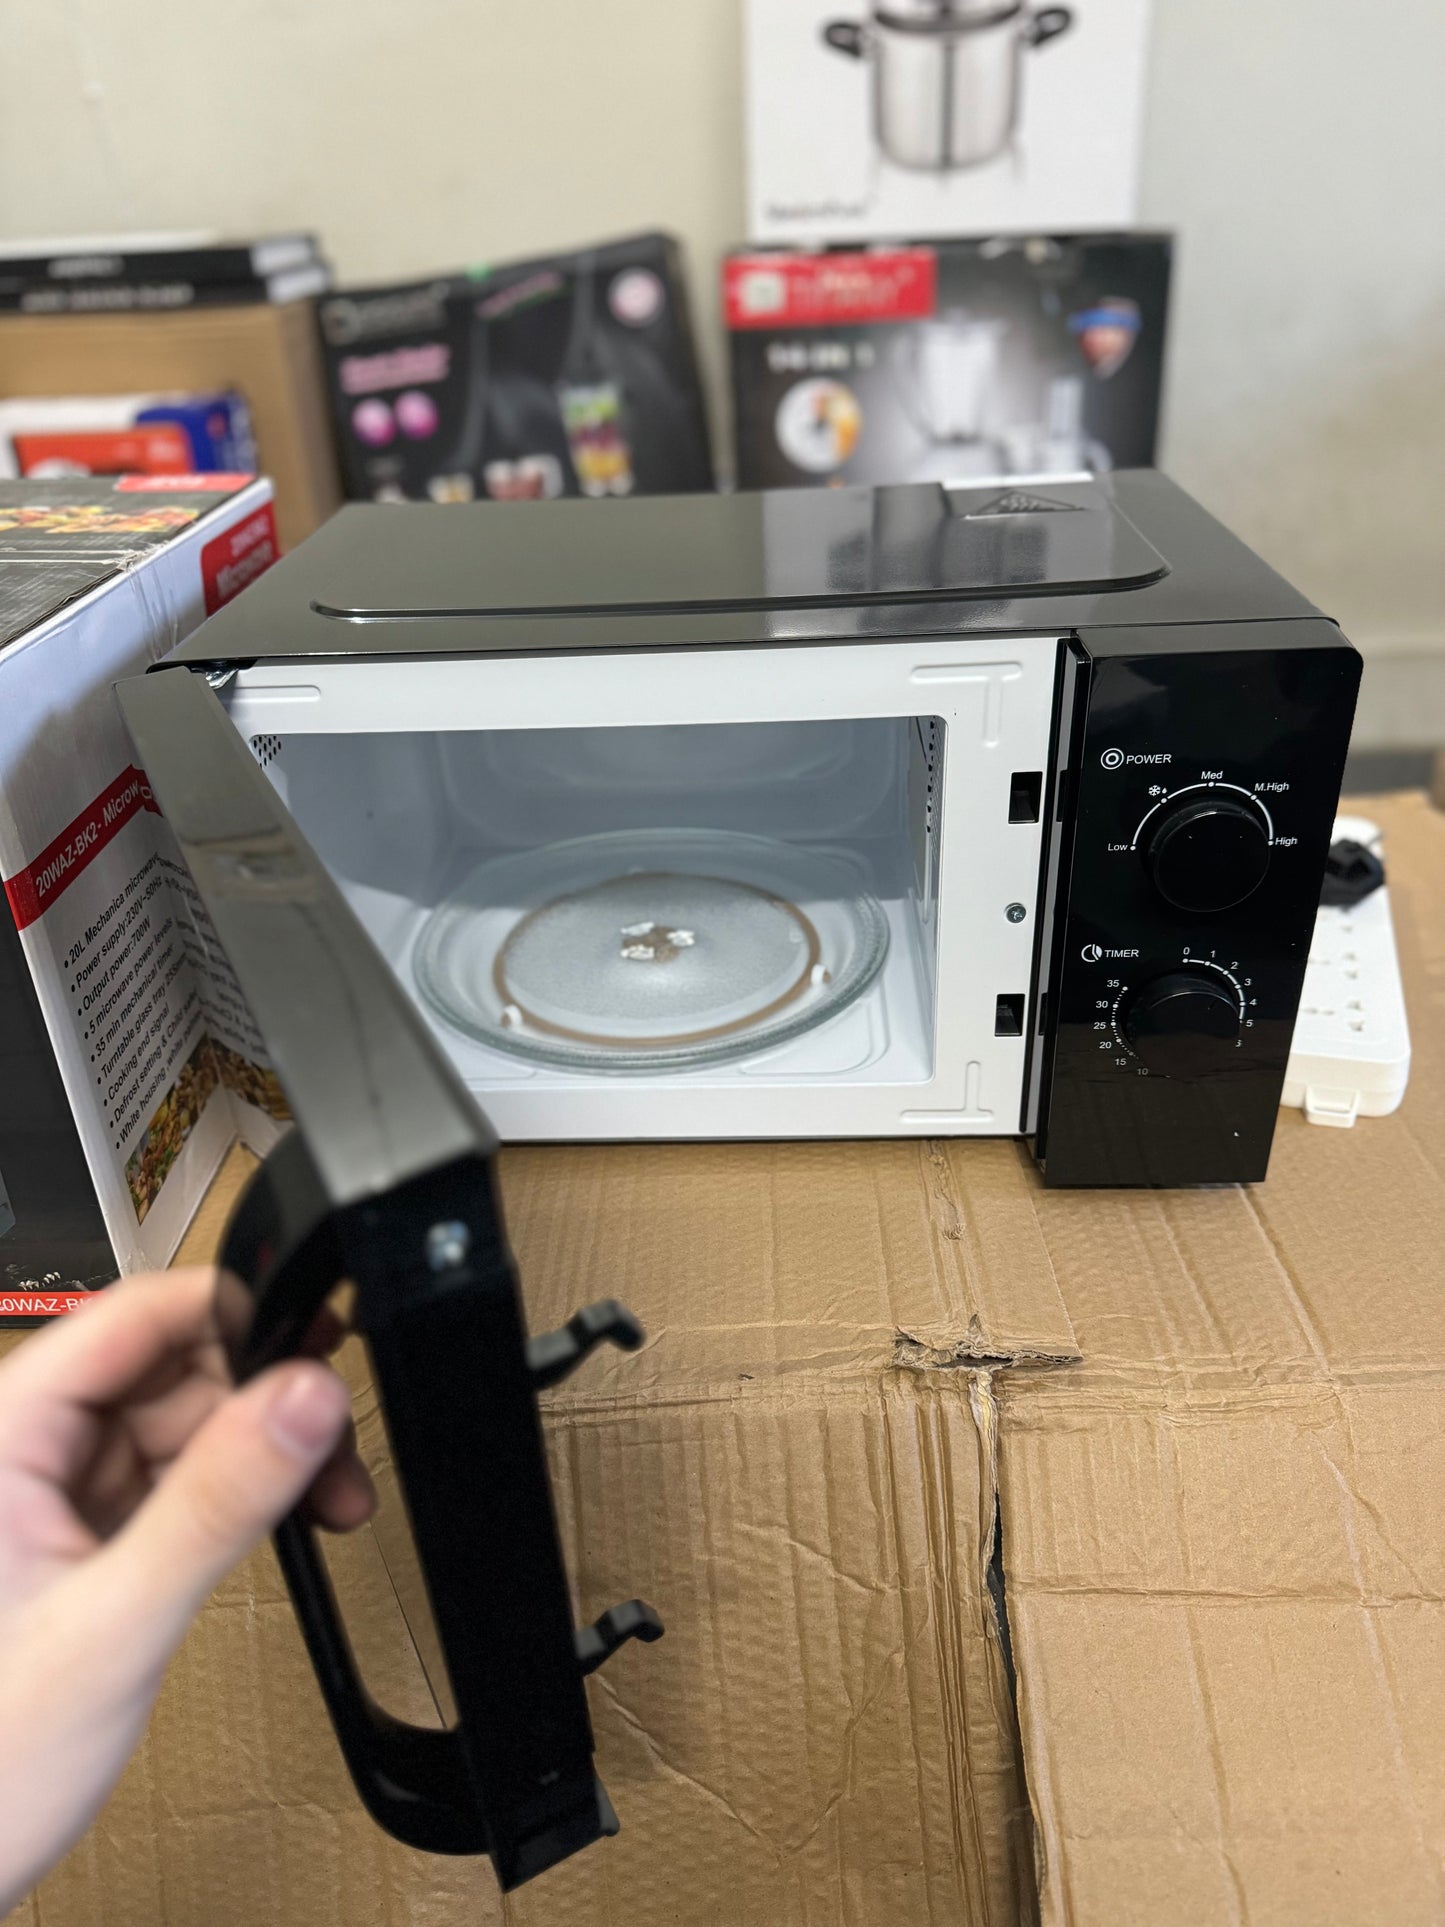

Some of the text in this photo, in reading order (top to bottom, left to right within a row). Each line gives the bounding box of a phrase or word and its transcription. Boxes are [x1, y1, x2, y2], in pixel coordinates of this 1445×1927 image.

[1126, 754, 1172, 765] POWER
[1201, 770, 1223, 780] Med
[1254, 782, 1290, 792] M.High
[1275, 836, 1298, 847] High
[1108, 843, 1128, 851] Low
[69, 940, 86, 965] 20L
[84, 893, 125, 946] Mechanica
[1104, 949, 1139, 958] TIMER
[1182, 947, 1191, 955] 0
[1210, 950, 1216, 958] 1
[83, 915, 151, 1011] Output power:700W
[1231, 961, 1239, 970] 2
[76, 951, 101, 989] Power
[89, 916, 173, 1034] 5 microwave power levels
[1106, 979, 1120, 988] 35
[1244, 978, 1252, 986] 3
[95, 943, 174, 1057] 35 min mechanical timer
[1096, 1000, 1108, 1009] 30
[1249, 998, 1257, 1006] 4
[1093, 1021, 1106, 1030] 25
[1245, 1019, 1253, 1027] 5
[101, 1028, 135, 1079] Turntable
[135, 1001, 153, 1034] glass
[153, 982, 166, 1005] tray
[1099, 1041, 1112, 1049] 20
[108, 1002, 170, 1100] Cooking end signal
[1115, 1057, 1127, 1066] 15
[1136, 1067, 1149, 1076] 10
[114, 1081, 140, 1123] Defrost
[140, 1045, 163, 1082] setting
[162, 1034, 168, 1048] &
[119, 1108, 140, 1144] White
[140, 1067, 166, 1112] housing
